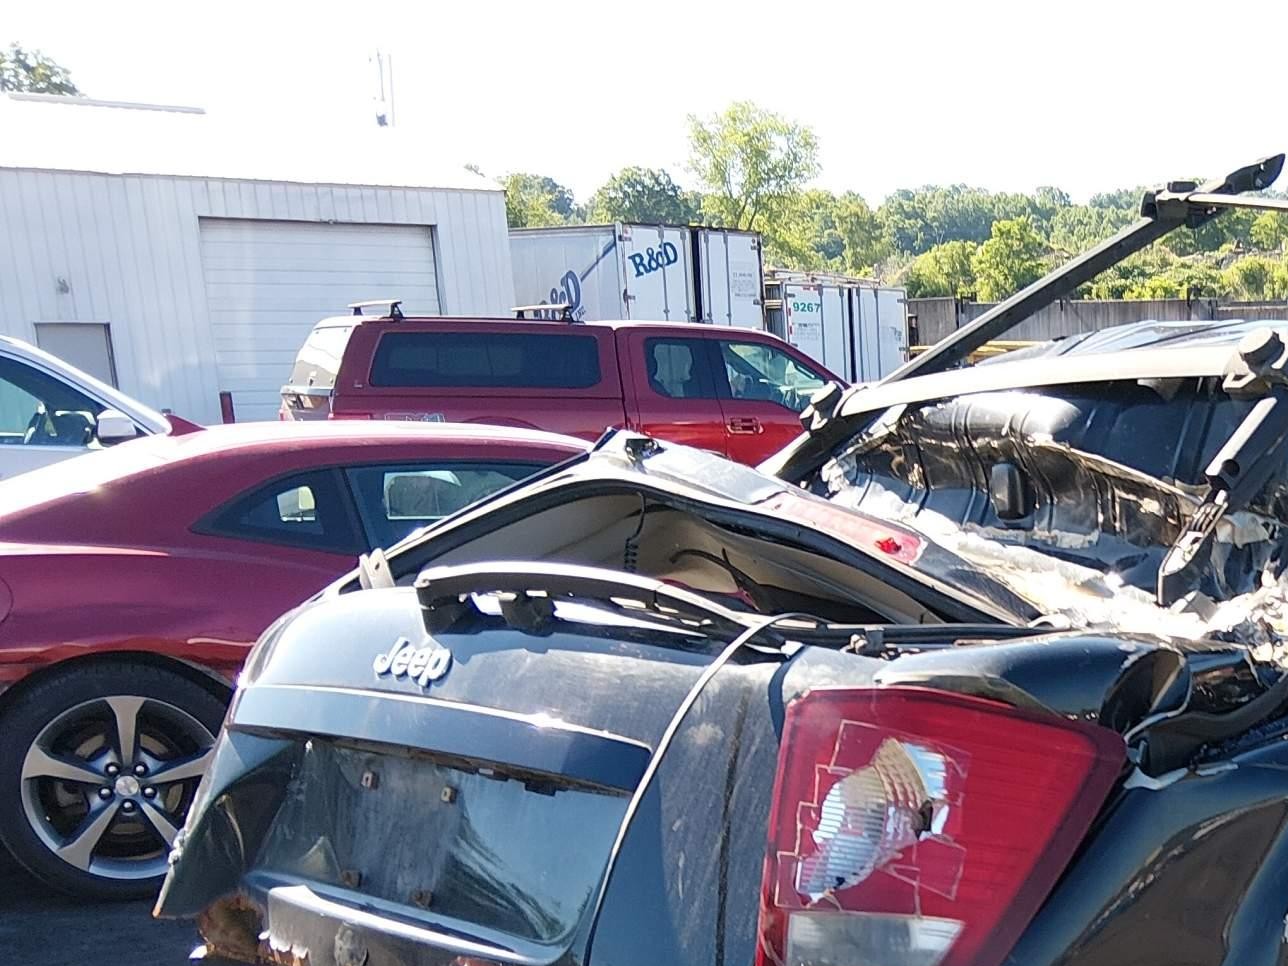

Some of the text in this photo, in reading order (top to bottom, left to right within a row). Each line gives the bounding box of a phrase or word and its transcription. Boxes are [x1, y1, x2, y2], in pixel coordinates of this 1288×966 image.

[628, 241, 678, 278] R&D
[792, 302, 821, 313] 9267
[373, 636, 452, 687] Jeep
